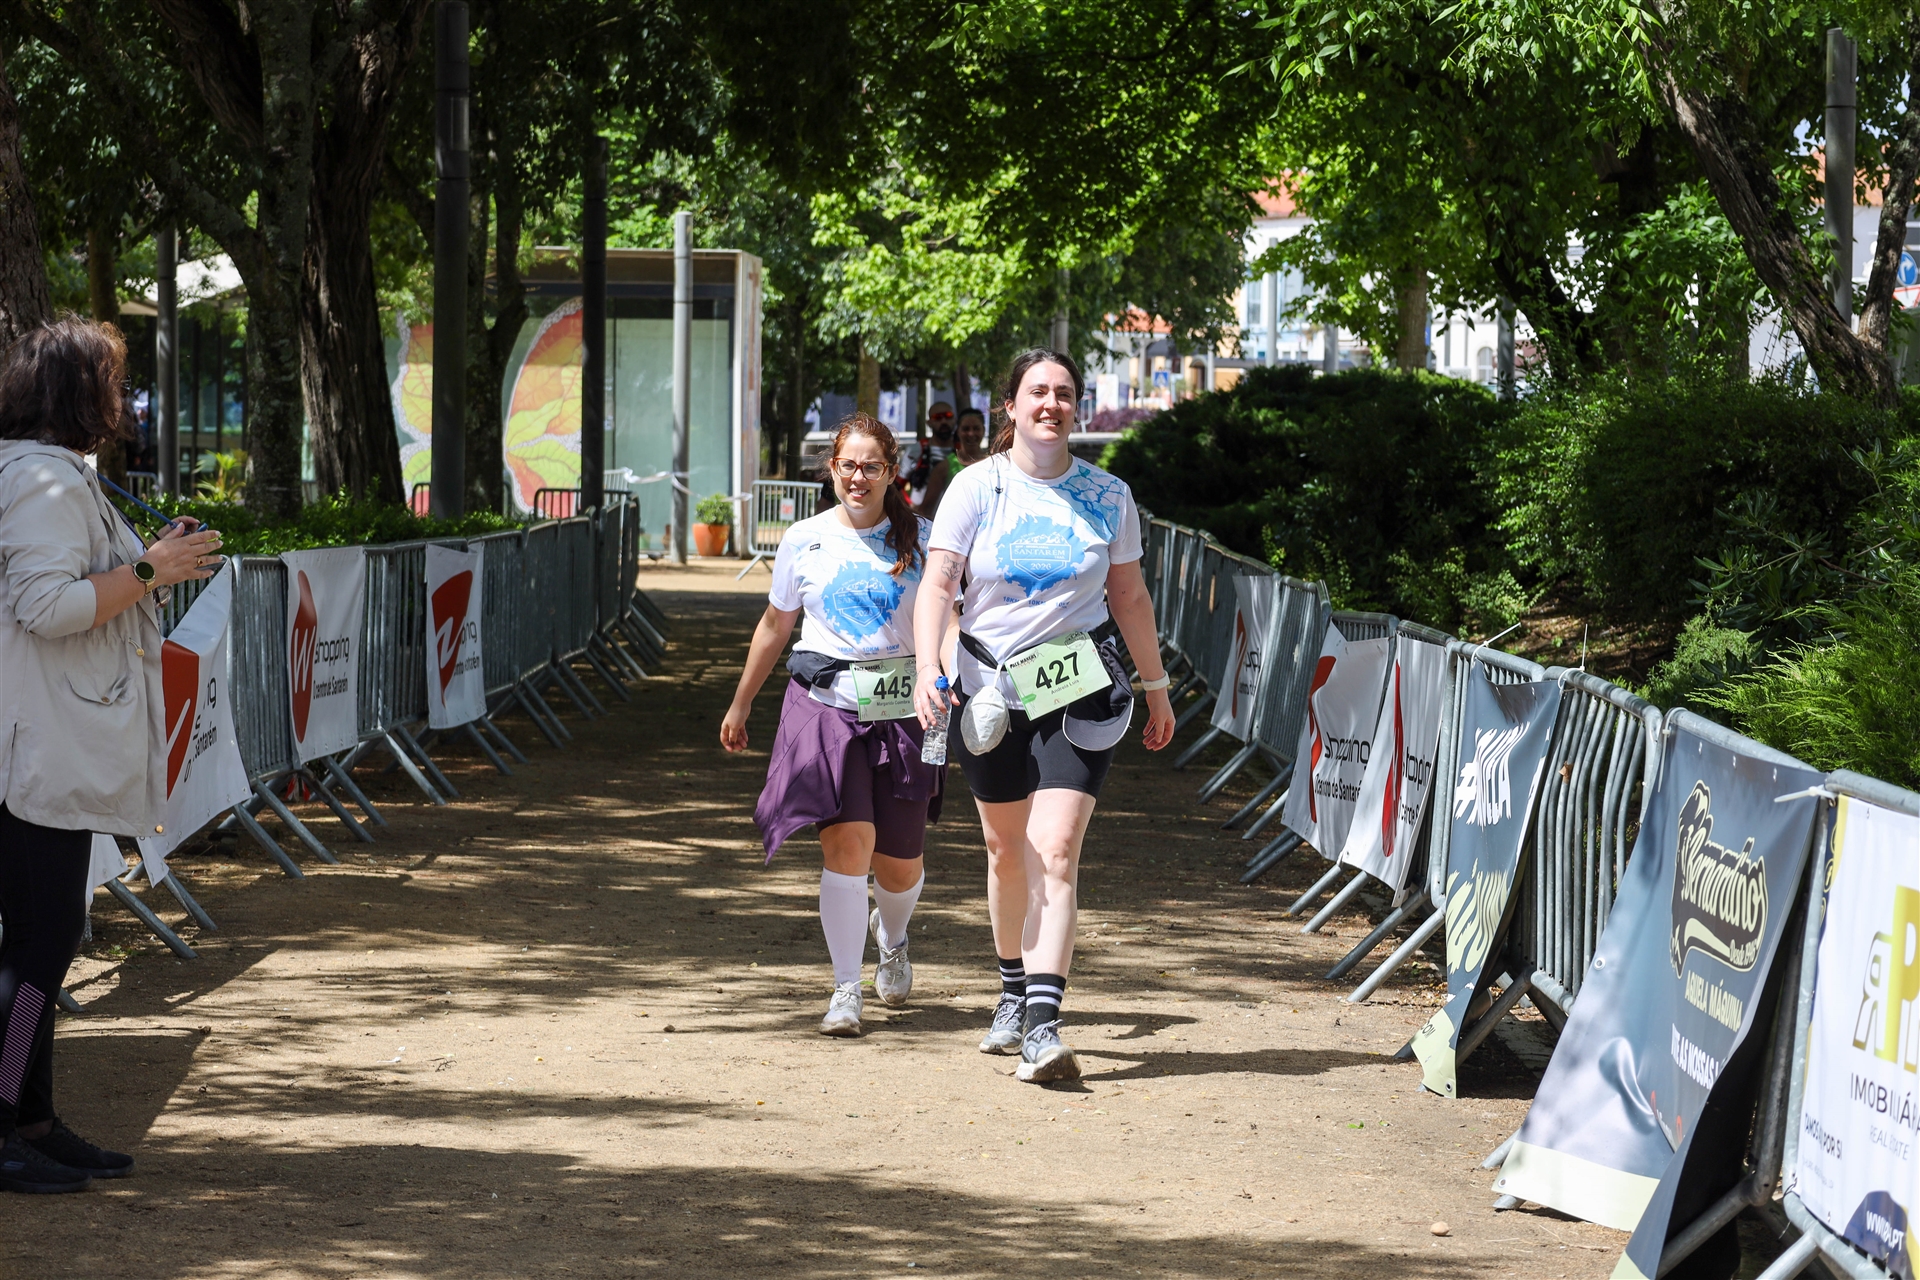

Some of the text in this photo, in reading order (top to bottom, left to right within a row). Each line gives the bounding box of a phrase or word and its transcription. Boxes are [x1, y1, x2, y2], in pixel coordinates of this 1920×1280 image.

[1014, 547, 1066, 556] SANTARÉM
[1030, 563, 1052, 571] 2026
[314, 635, 350, 667] shopping
[1035, 651, 1080, 689] 427
[873, 675, 912, 700] 445
[1685, 970, 1743, 1033] AQUELA MÁQUINA
[1687, 1042, 1715, 1091] NOSSAS
